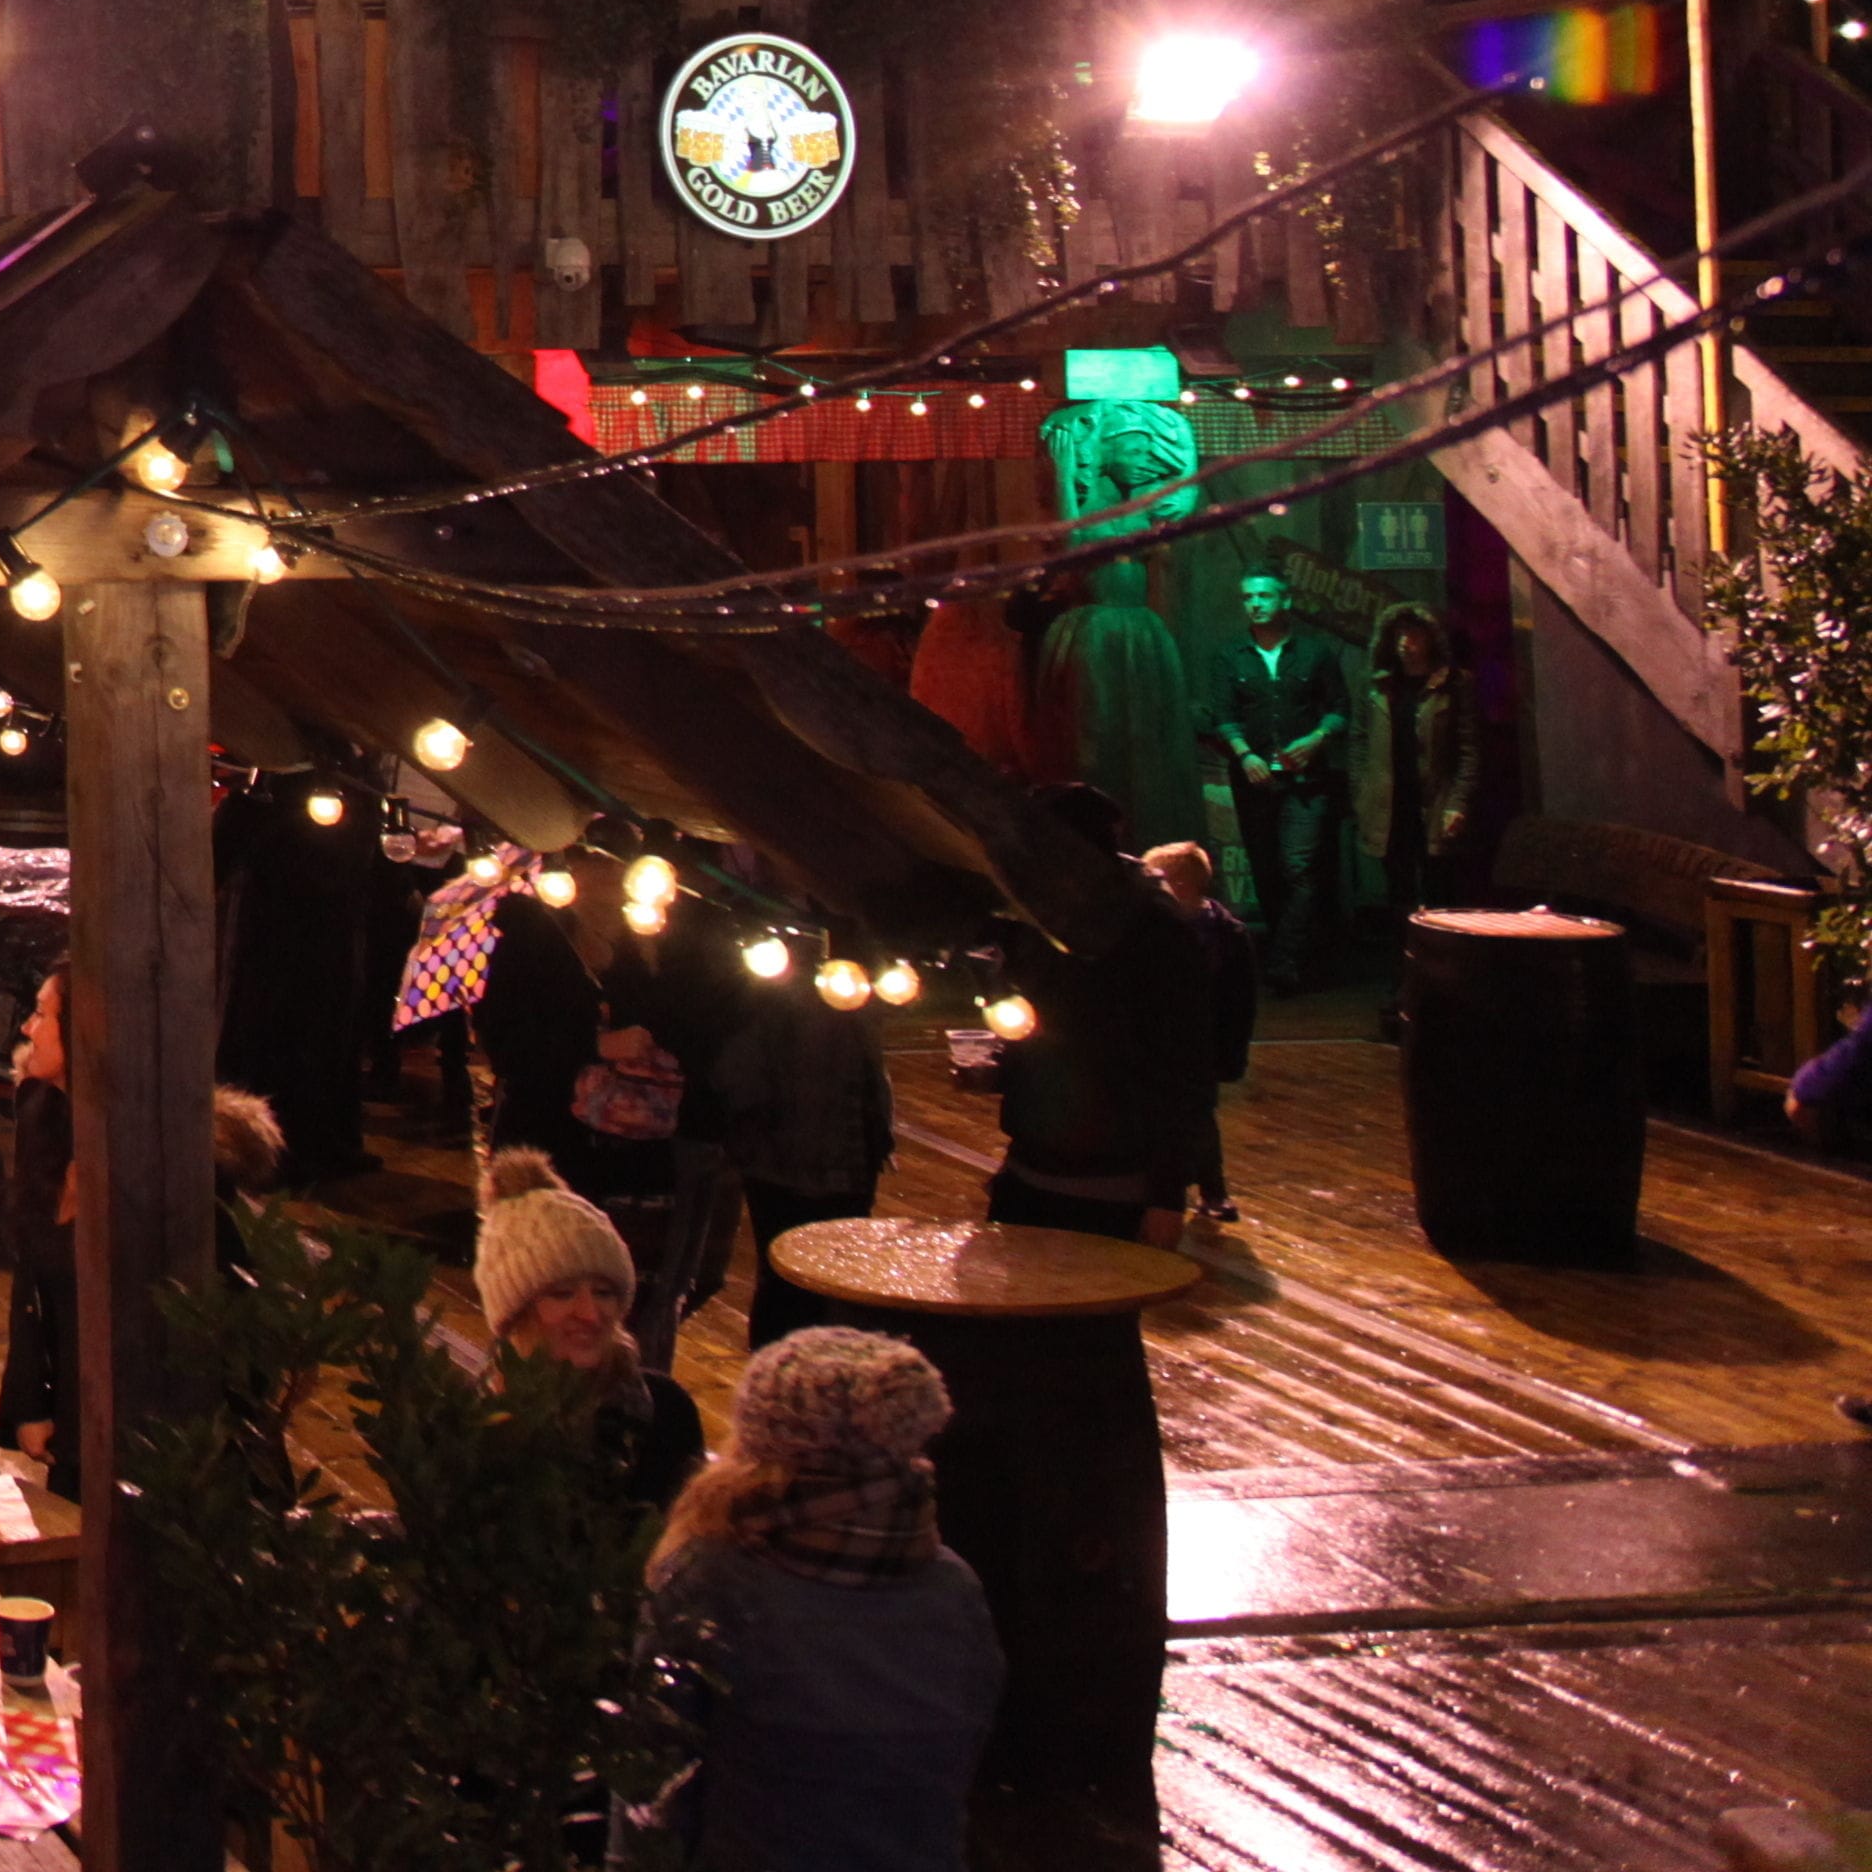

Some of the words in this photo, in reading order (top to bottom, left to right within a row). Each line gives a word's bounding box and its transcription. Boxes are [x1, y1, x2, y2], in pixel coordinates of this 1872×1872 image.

[690, 49, 827, 103] BAVARIAN
[687, 167, 758, 225] GOLD
[767, 169, 835, 226] BEER
[1375, 551, 1433, 565] TOILETS
